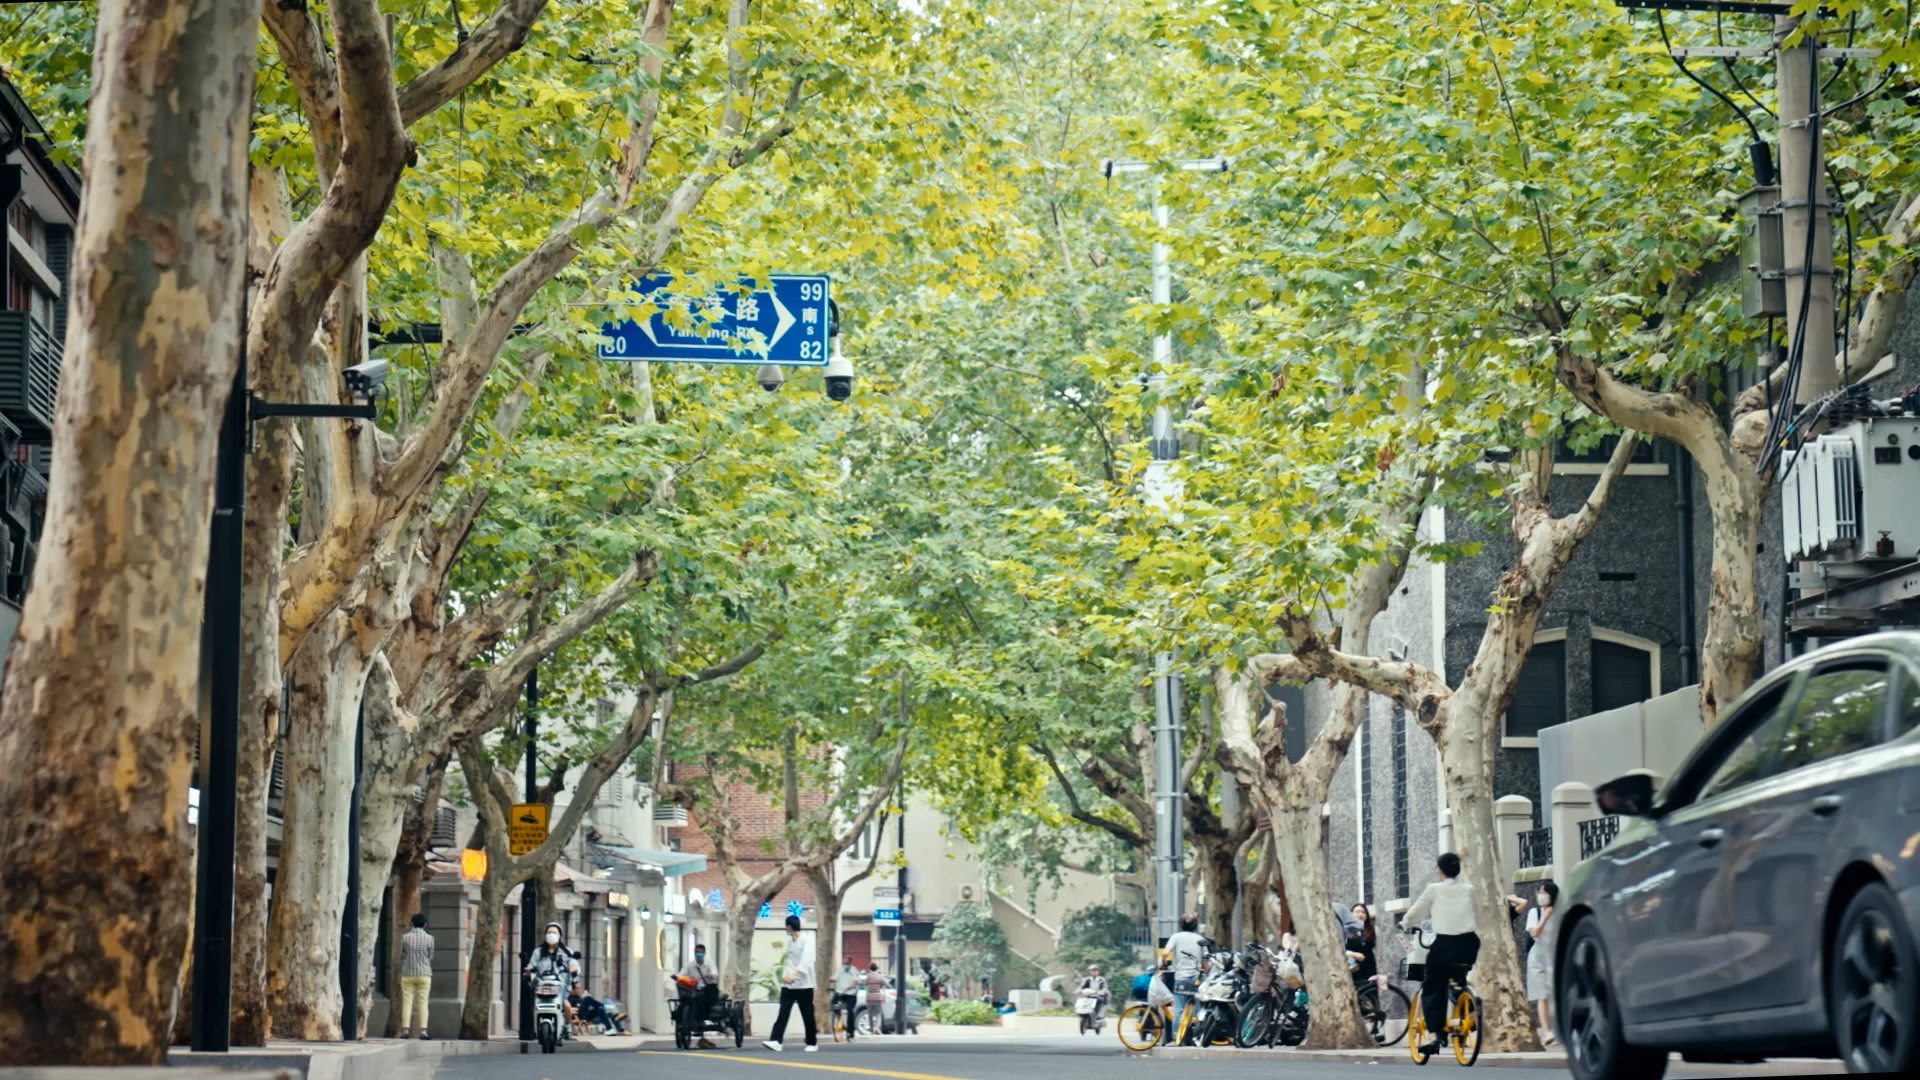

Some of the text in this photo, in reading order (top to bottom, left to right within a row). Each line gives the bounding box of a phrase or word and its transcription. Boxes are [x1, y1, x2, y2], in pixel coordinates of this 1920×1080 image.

[801, 283, 822, 301] 99
[802, 307, 818, 324] 南
[806, 326, 815, 336] S
[800, 341, 822, 359] 82
